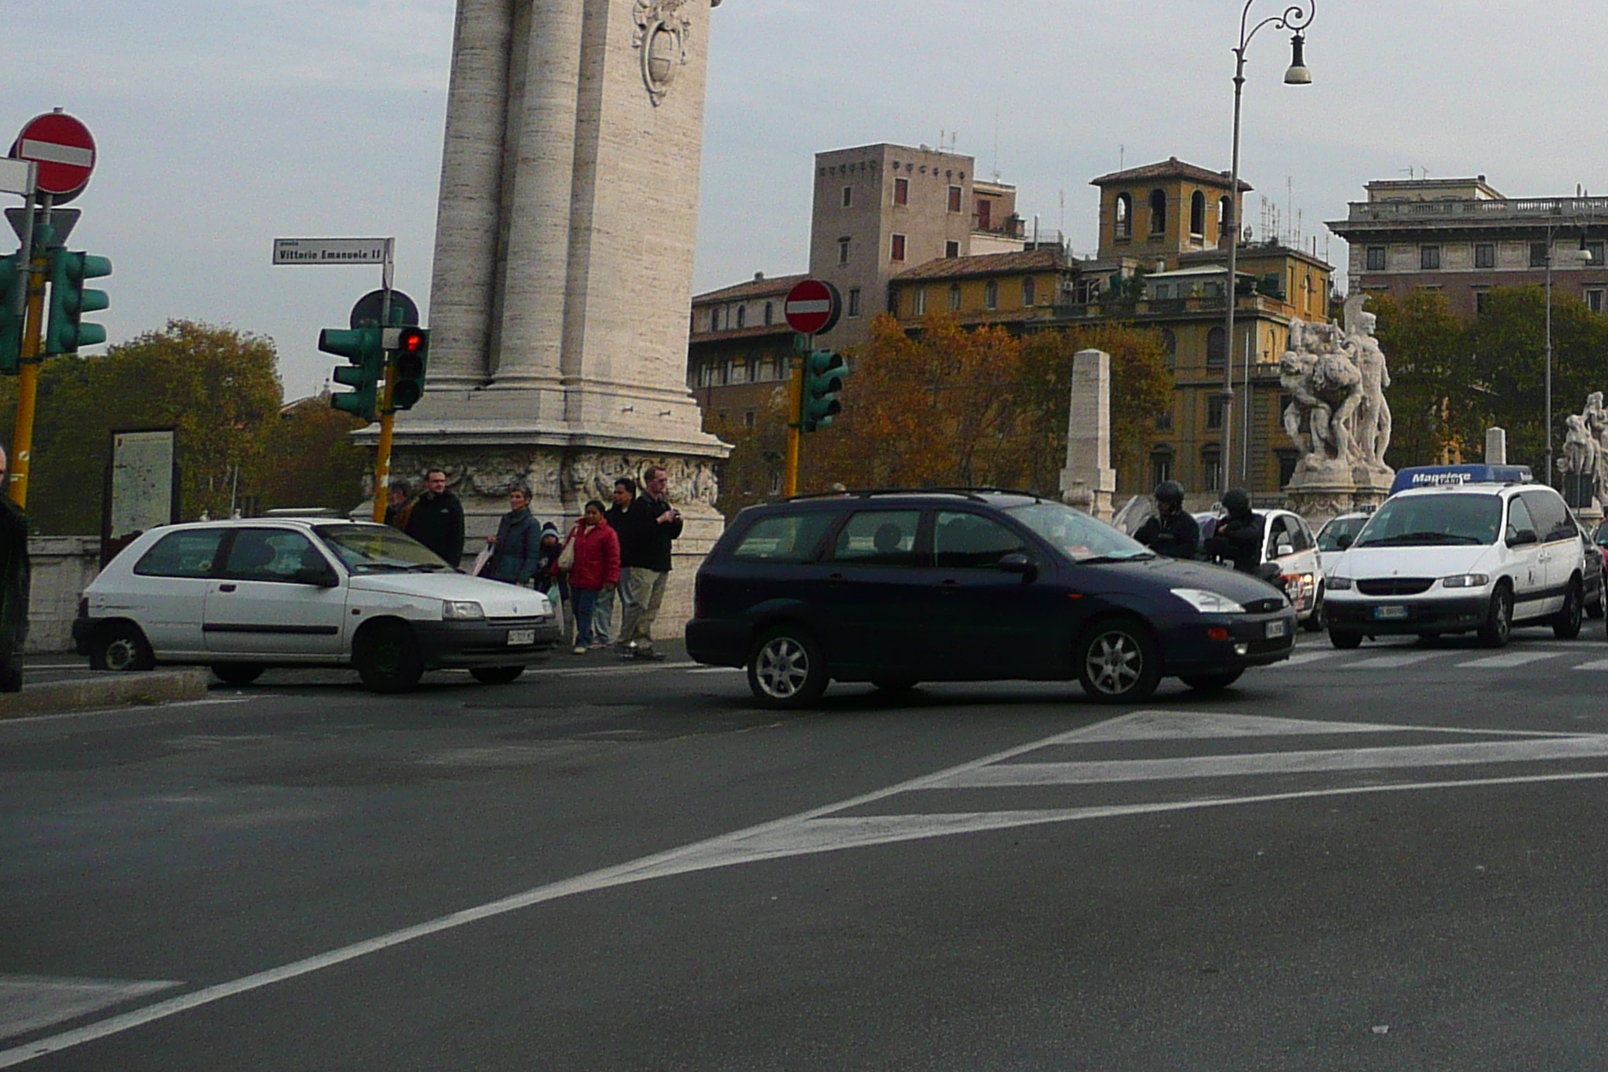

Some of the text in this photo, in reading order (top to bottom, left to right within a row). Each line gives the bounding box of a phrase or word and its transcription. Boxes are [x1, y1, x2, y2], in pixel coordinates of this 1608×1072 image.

[280, 249, 381, 259] Vittorio Emanuele II
